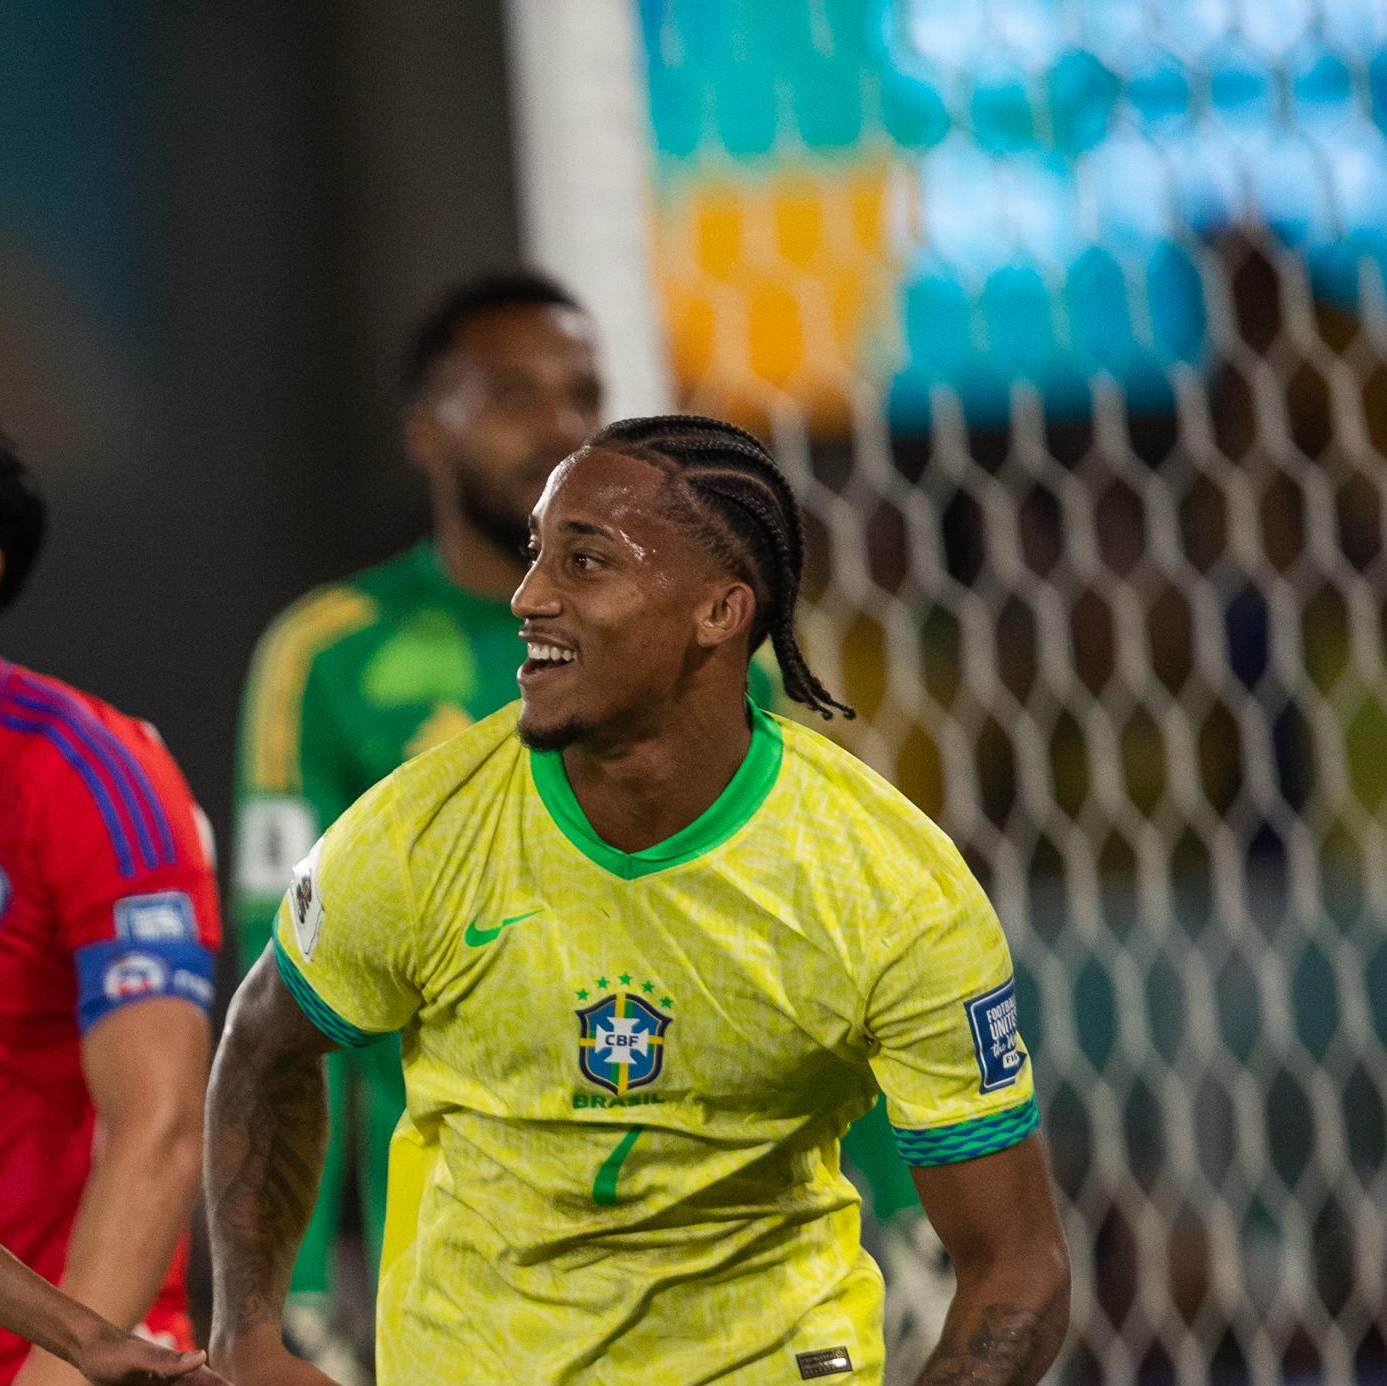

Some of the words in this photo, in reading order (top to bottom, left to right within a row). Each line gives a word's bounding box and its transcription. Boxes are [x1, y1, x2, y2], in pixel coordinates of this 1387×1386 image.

[986, 994, 1017, 1023] FOOTBA
[989, 1009, 1017, 1040] UNITE
[605, 1033, 639, 1048] CBF
[572, 1093, 665, 1110] BRASIL
[592, 1124, 644, 1206] 7
